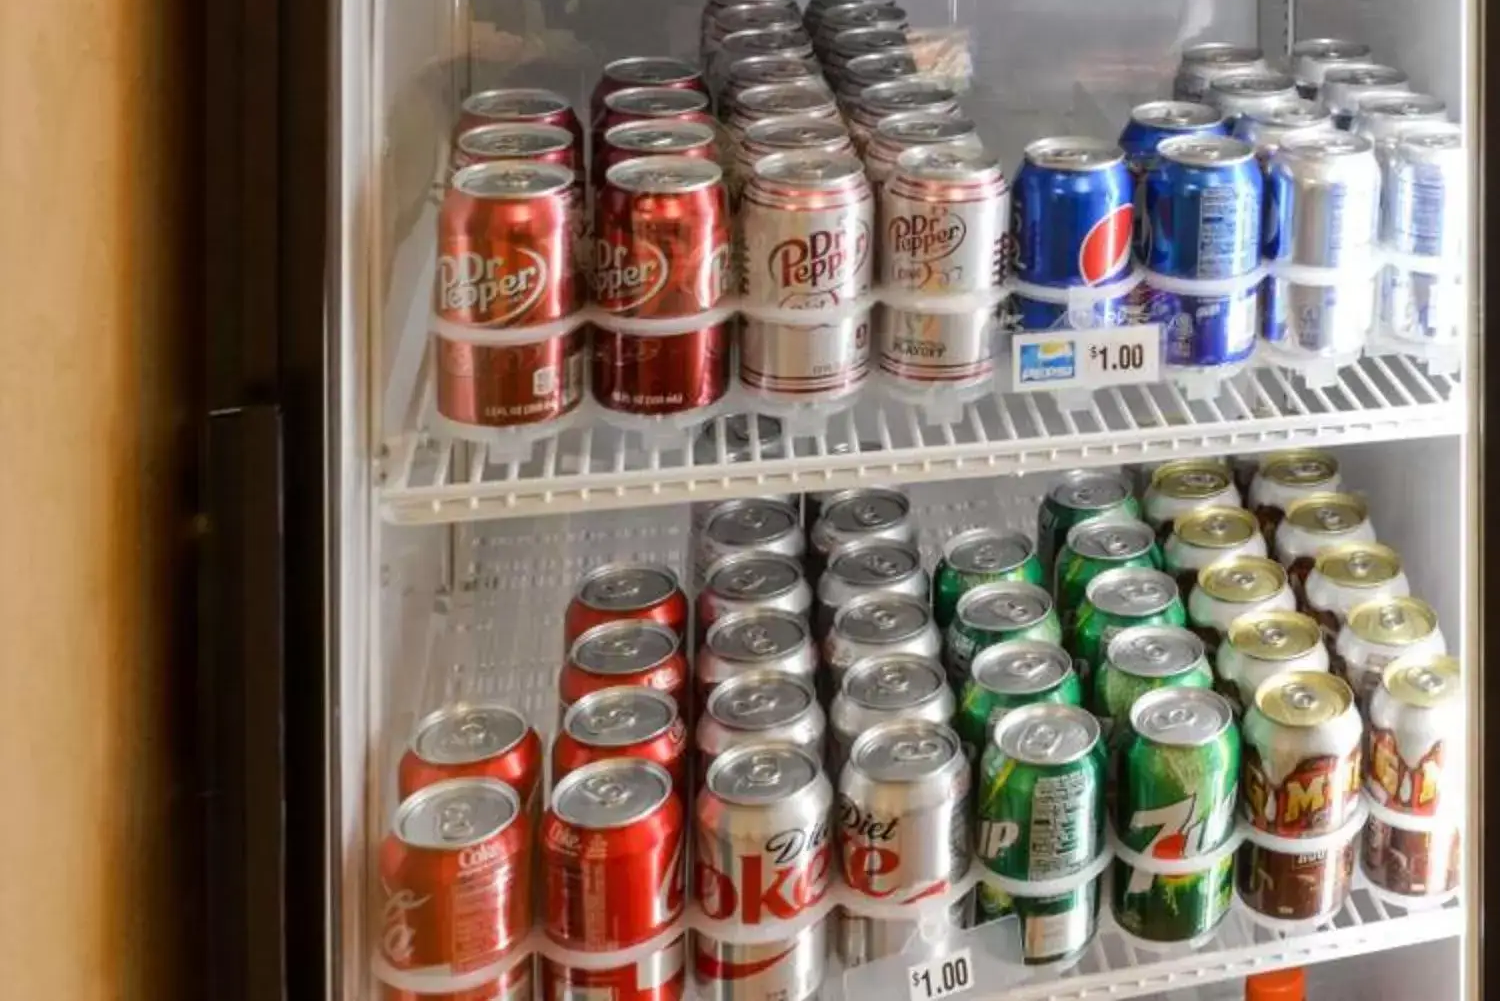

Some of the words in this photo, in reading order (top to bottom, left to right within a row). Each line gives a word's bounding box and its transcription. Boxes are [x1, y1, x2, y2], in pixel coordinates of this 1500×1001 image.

[891, 216, 960, 258] Pepper
[911, 214, 940, 236] Dr
[809, 229, 847, 259] Dr
[463, 251, 505, 285] Dr
[1089, 343, 1144, 372] $1.00
[694, 846, 832, 925] oke
[911, 956, 969, 998] $1.00
